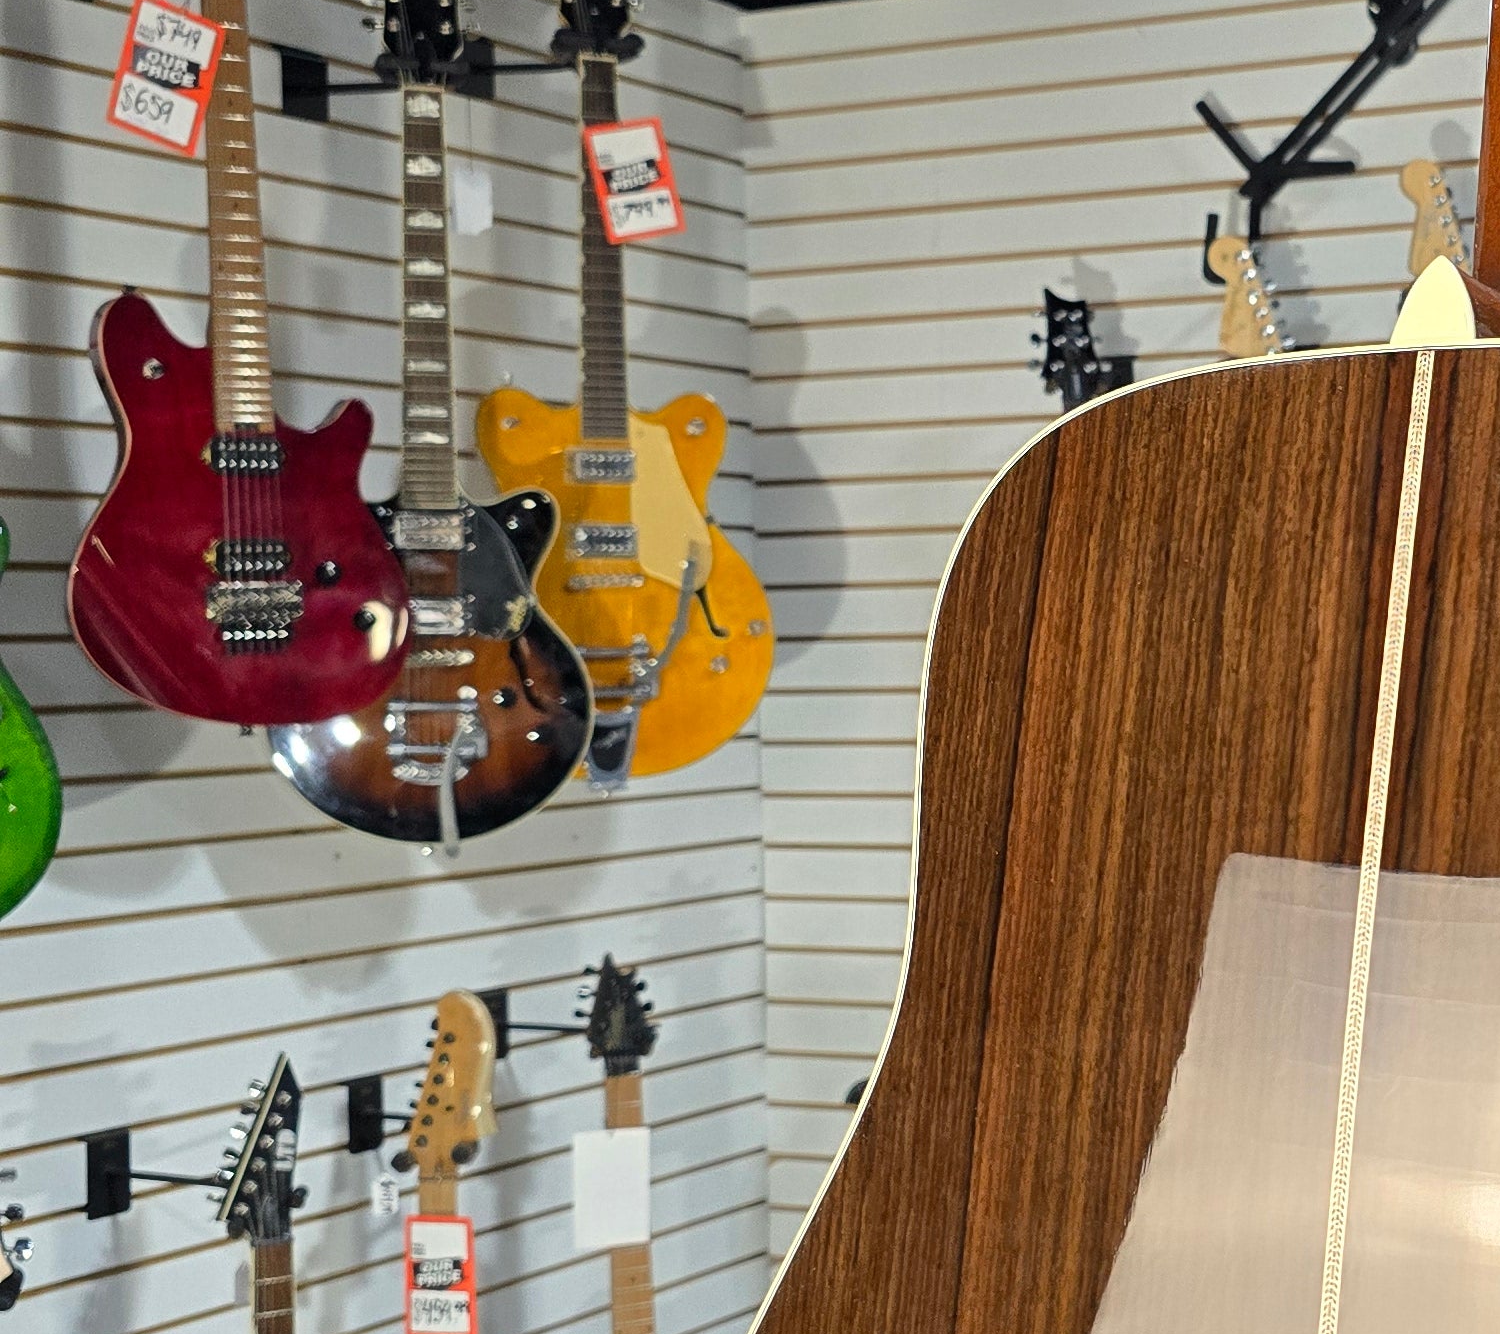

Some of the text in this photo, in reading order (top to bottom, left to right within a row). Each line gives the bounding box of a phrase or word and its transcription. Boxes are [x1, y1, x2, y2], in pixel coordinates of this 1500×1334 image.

[136, 59, 197, 88] PRICE
[146, 50, 189, 73] OUR
[120, 82, 175, 124] $659
